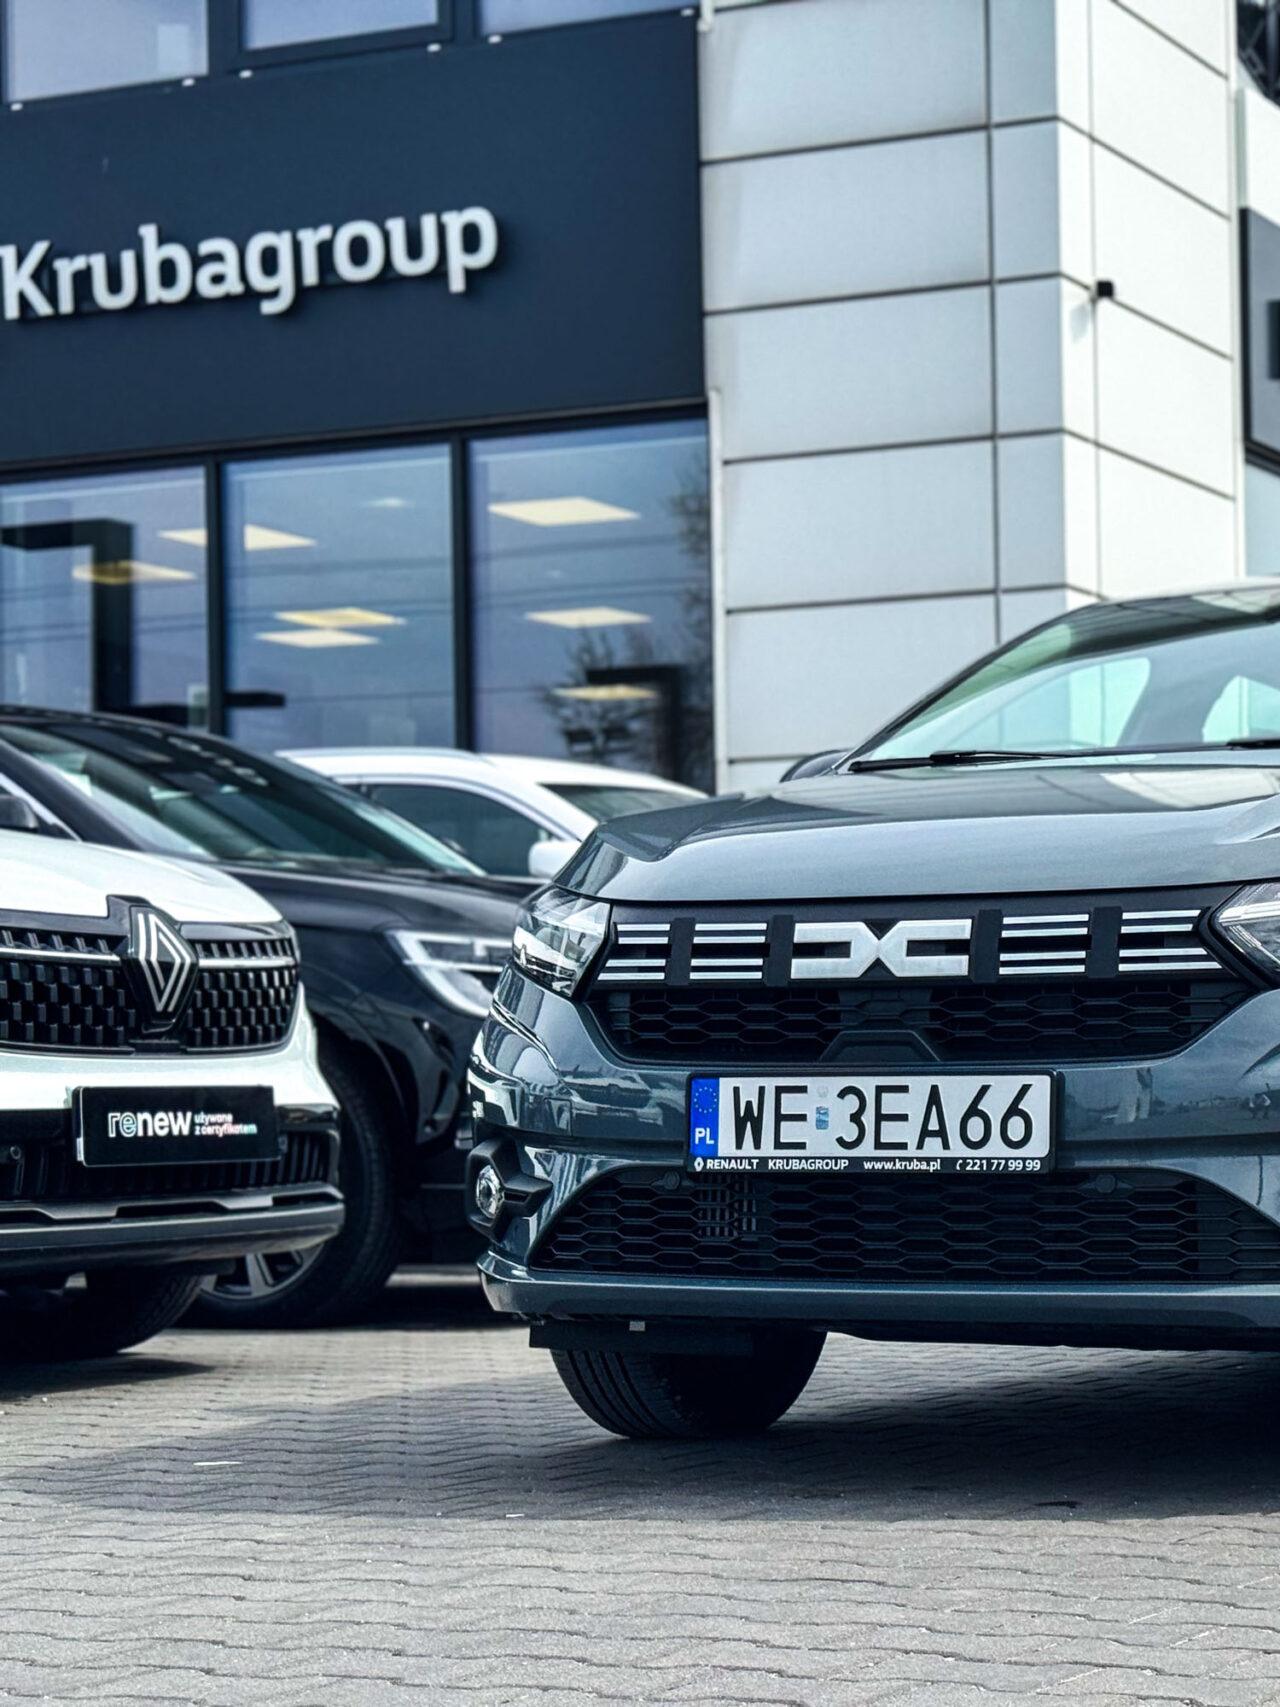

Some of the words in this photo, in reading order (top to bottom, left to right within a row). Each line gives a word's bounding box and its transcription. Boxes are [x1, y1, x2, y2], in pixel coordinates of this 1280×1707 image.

[0, 205, 498, 320] Krubagroup
[107, 1111, 192, 1138] renew
[732, 1084, 808, 1151] WE
[835, 1083, 1034, 1151] 3EA66
[694, 1127, 715, 1146] PL
[705, 1158, 760, 1171] RENAULT
[767, 1158, 850, 1171] KRUBAGROUP
[863, 1158, 942, 1173] www.kruba.pl
[965, 1158, 987, 1171] 221
[990, 1158, 1006, 1171] 77
[1007, 1158, 1024, 1171] 99
[1025, 1158, 1041, 1171] 99
